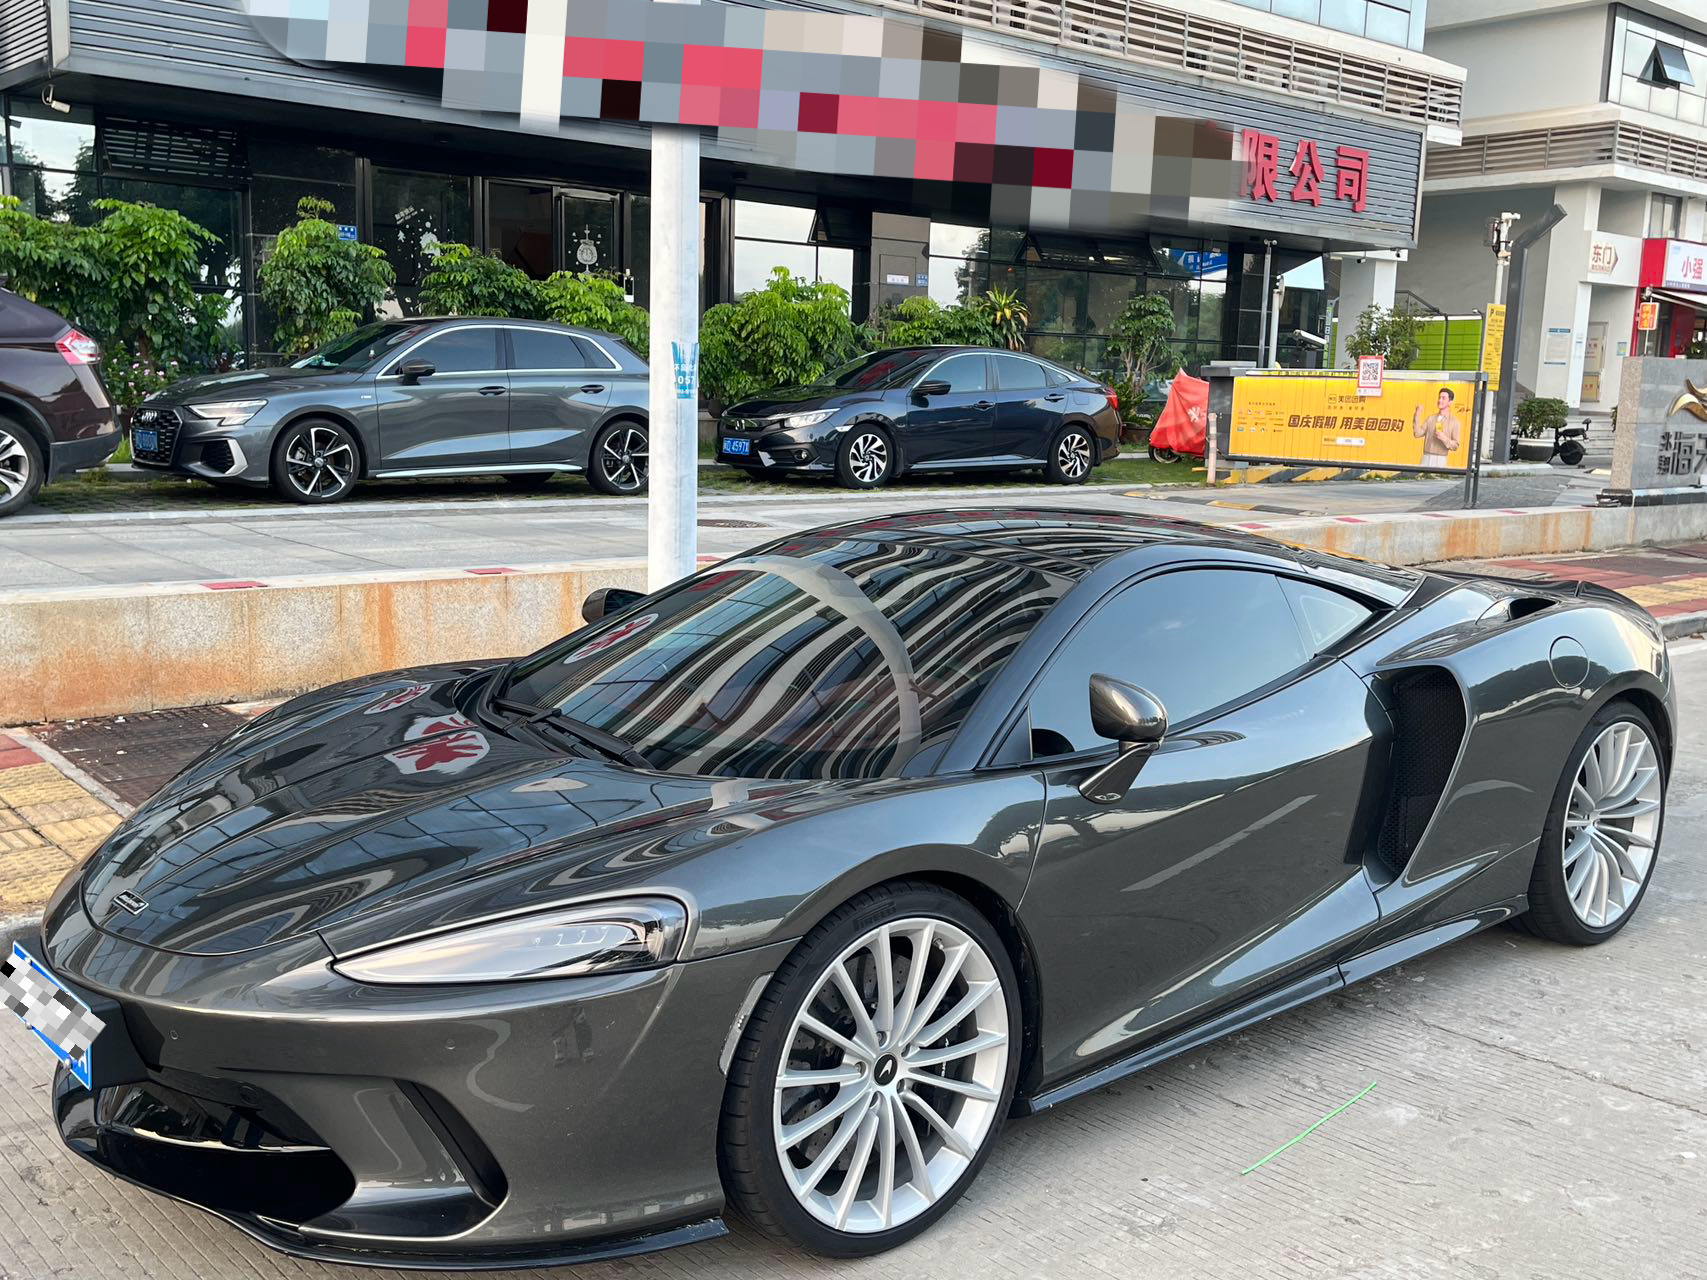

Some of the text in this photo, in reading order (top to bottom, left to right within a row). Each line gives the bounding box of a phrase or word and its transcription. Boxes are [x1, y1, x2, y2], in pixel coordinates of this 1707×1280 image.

[1240, 128, 1370, 213] 限公司
[1592, 244, 1612, 264] 东门
[1288, 414, 1338, 430] 国庆假期
[1340, 416, 1405, 432] 用美团团购
